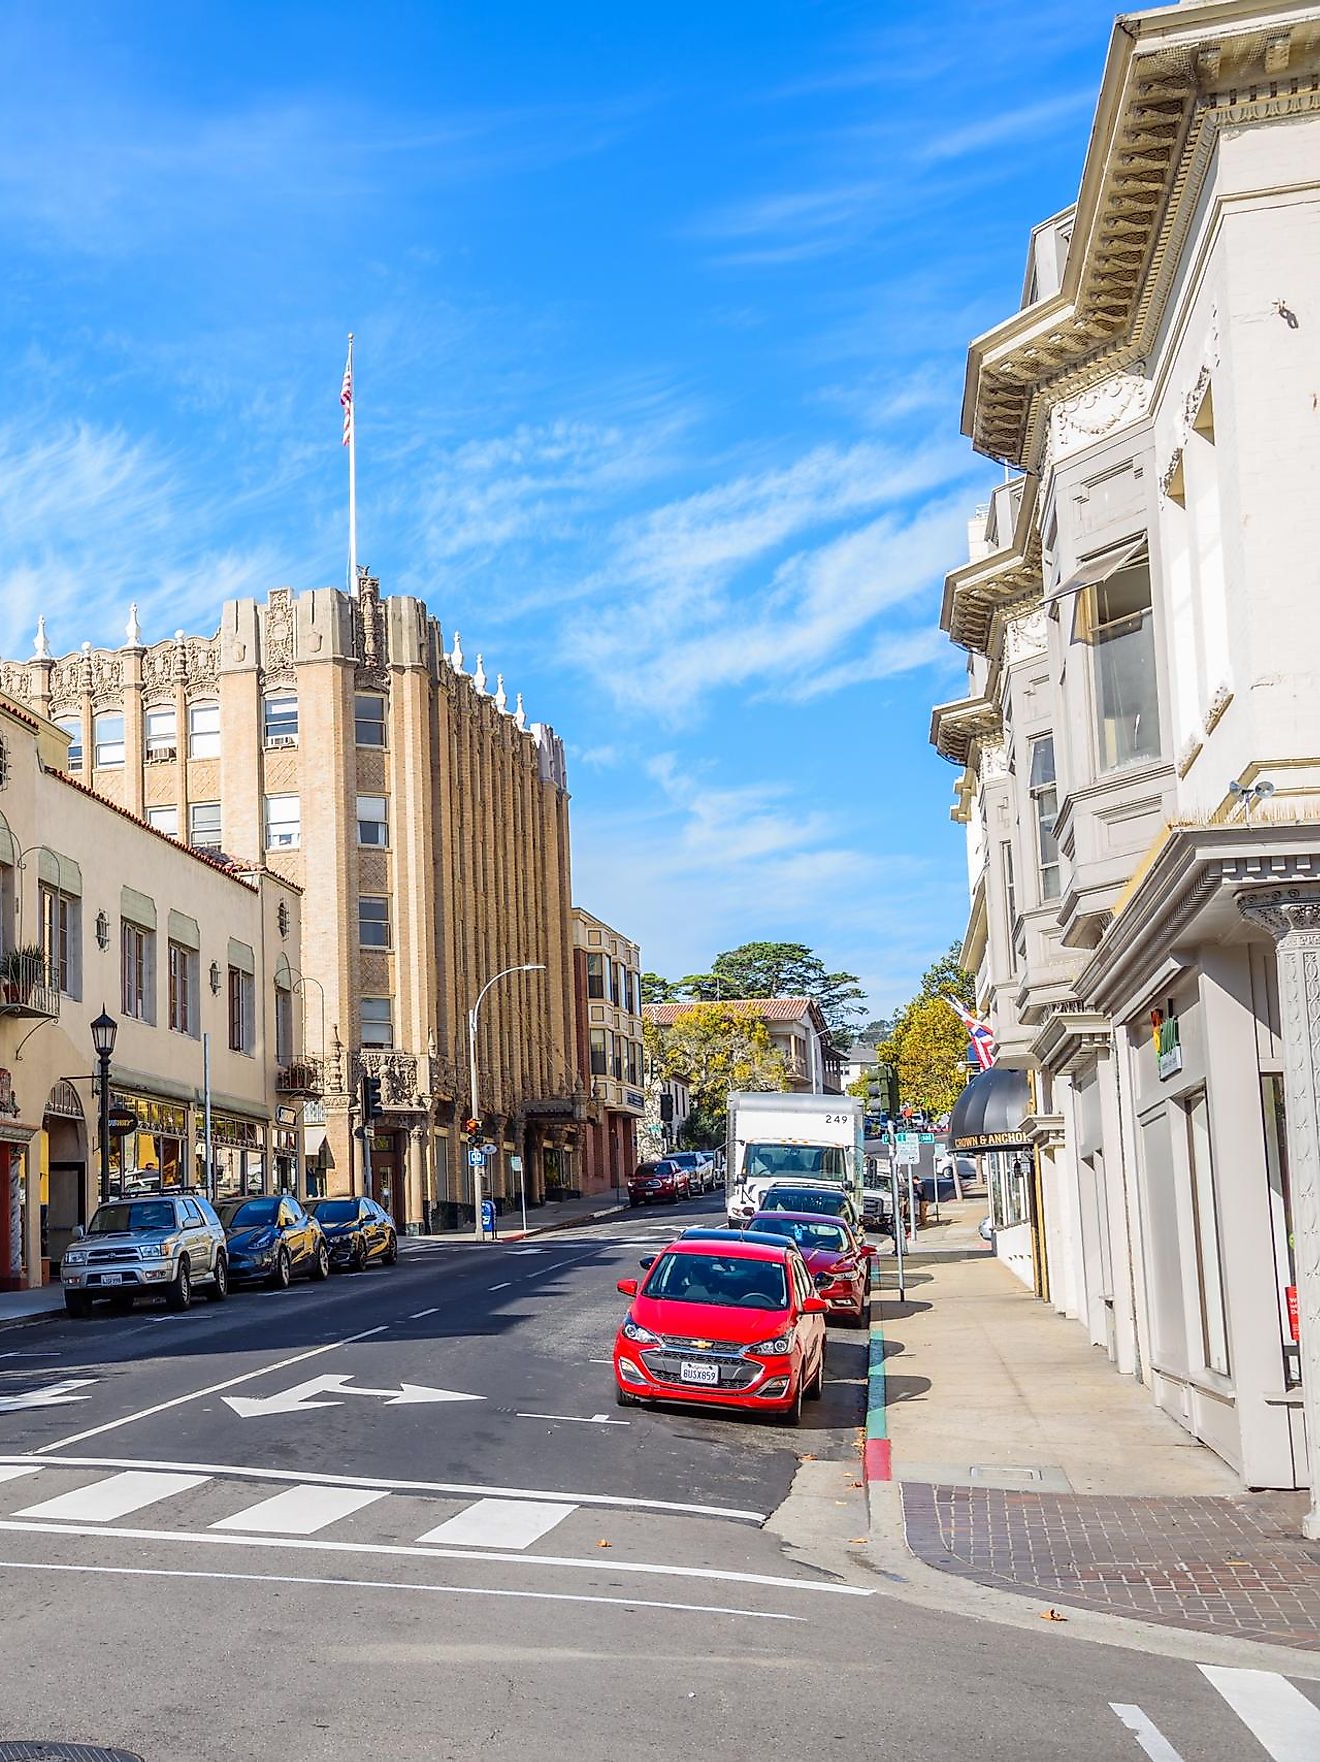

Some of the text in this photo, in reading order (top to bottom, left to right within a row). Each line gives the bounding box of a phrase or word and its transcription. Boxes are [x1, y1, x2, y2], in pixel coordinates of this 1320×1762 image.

[825, 1114, 848, 1124] 249
[955, 1137, 977, 1148] CROWN
[980, 1135, 986, 1145] &
